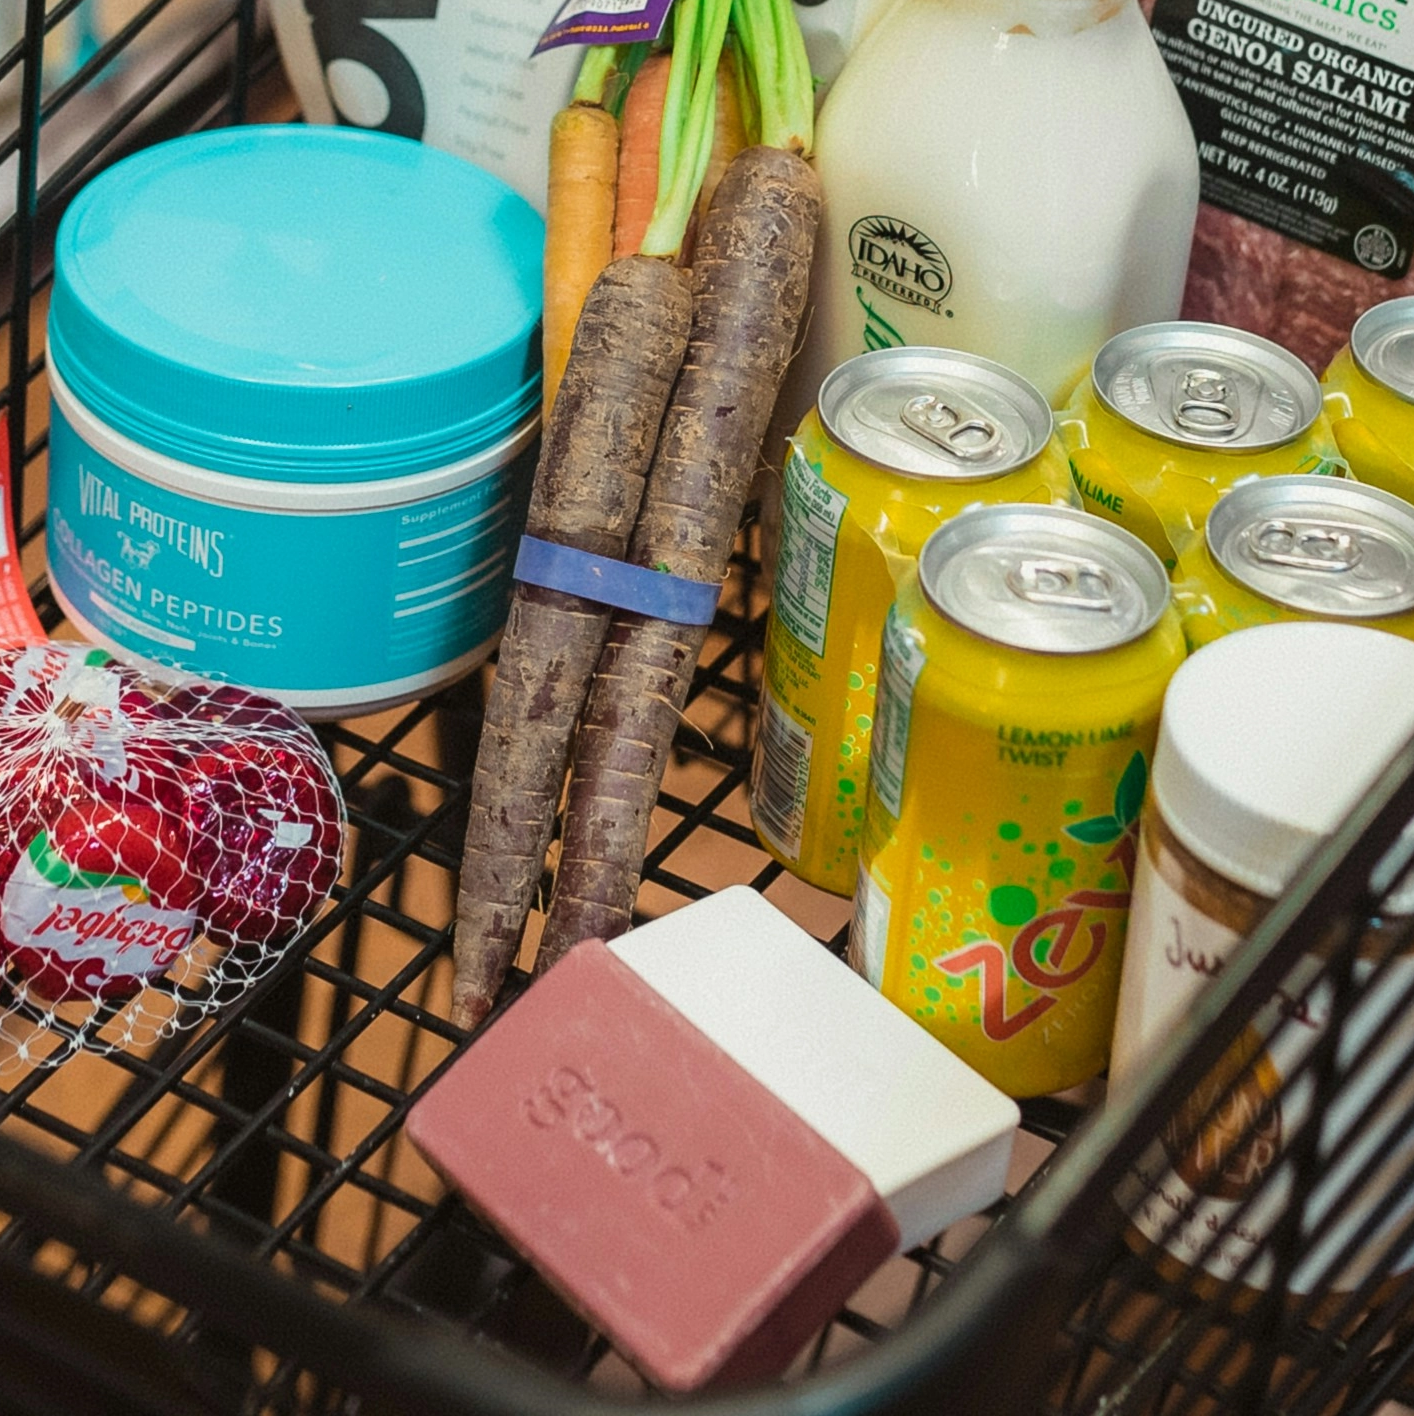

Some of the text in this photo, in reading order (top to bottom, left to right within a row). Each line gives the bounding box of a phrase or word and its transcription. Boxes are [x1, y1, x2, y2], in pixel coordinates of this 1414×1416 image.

[1294, 9, 1313, 25] THE
[1314, 18, 1343, 35] MEAT
[1346, 31, 1363, 44] WE
[1167, 31, 1206, 59] nitrites
[1206, 49, 1219, 63] or
[1219, 52, 1262, 83] nitrates
[1262, 76, 1297, 97] added
[1297, 87, 1335, 113] except
[1335, 101, 1354, 120] for
[1353, 108, 1386, 131] those
[1187, 17, 1412, 124] GENOA SALAMI
[1183, 75, 1249, 112] ANTIBIOTICS
[1293, 123, 1356, 156] HUMANELY
[1212, 66, 1232, 84] sea
[1233, 68, 1254, 92] salt
[1253, 83, 1276, 103] and
[1276, 90, 1323, 123] cultured
[1322, 113, 1356, 138] celery
[1356, 127, 1385, 149] juice
[1219, 108, 1338, 165] GLUTEN & CASEIN FREE
[1220, 129, 1328, 181] KEEP REFRIGERATED
[1198, 141, 1340, 216] NET WT. 4 OZ. (113g)
[857, 236, 945, 293] IDAHO
[862, 268, 931, 307] PREFERRED
[78, 463, 225, 578] VITAL PROTEINS
[401, 490, 483, 525] Supplement
[1084, 479, 1125, 515] LIME
[53, 507, 142, 602] COLLAGEN
[150, 588, 284, 638] PEPTIDES
[997, 723, 1085, 747] LEMON
[997, 745, 1069, 771] TWIST
[31, 902, 192, 966] Babybel
